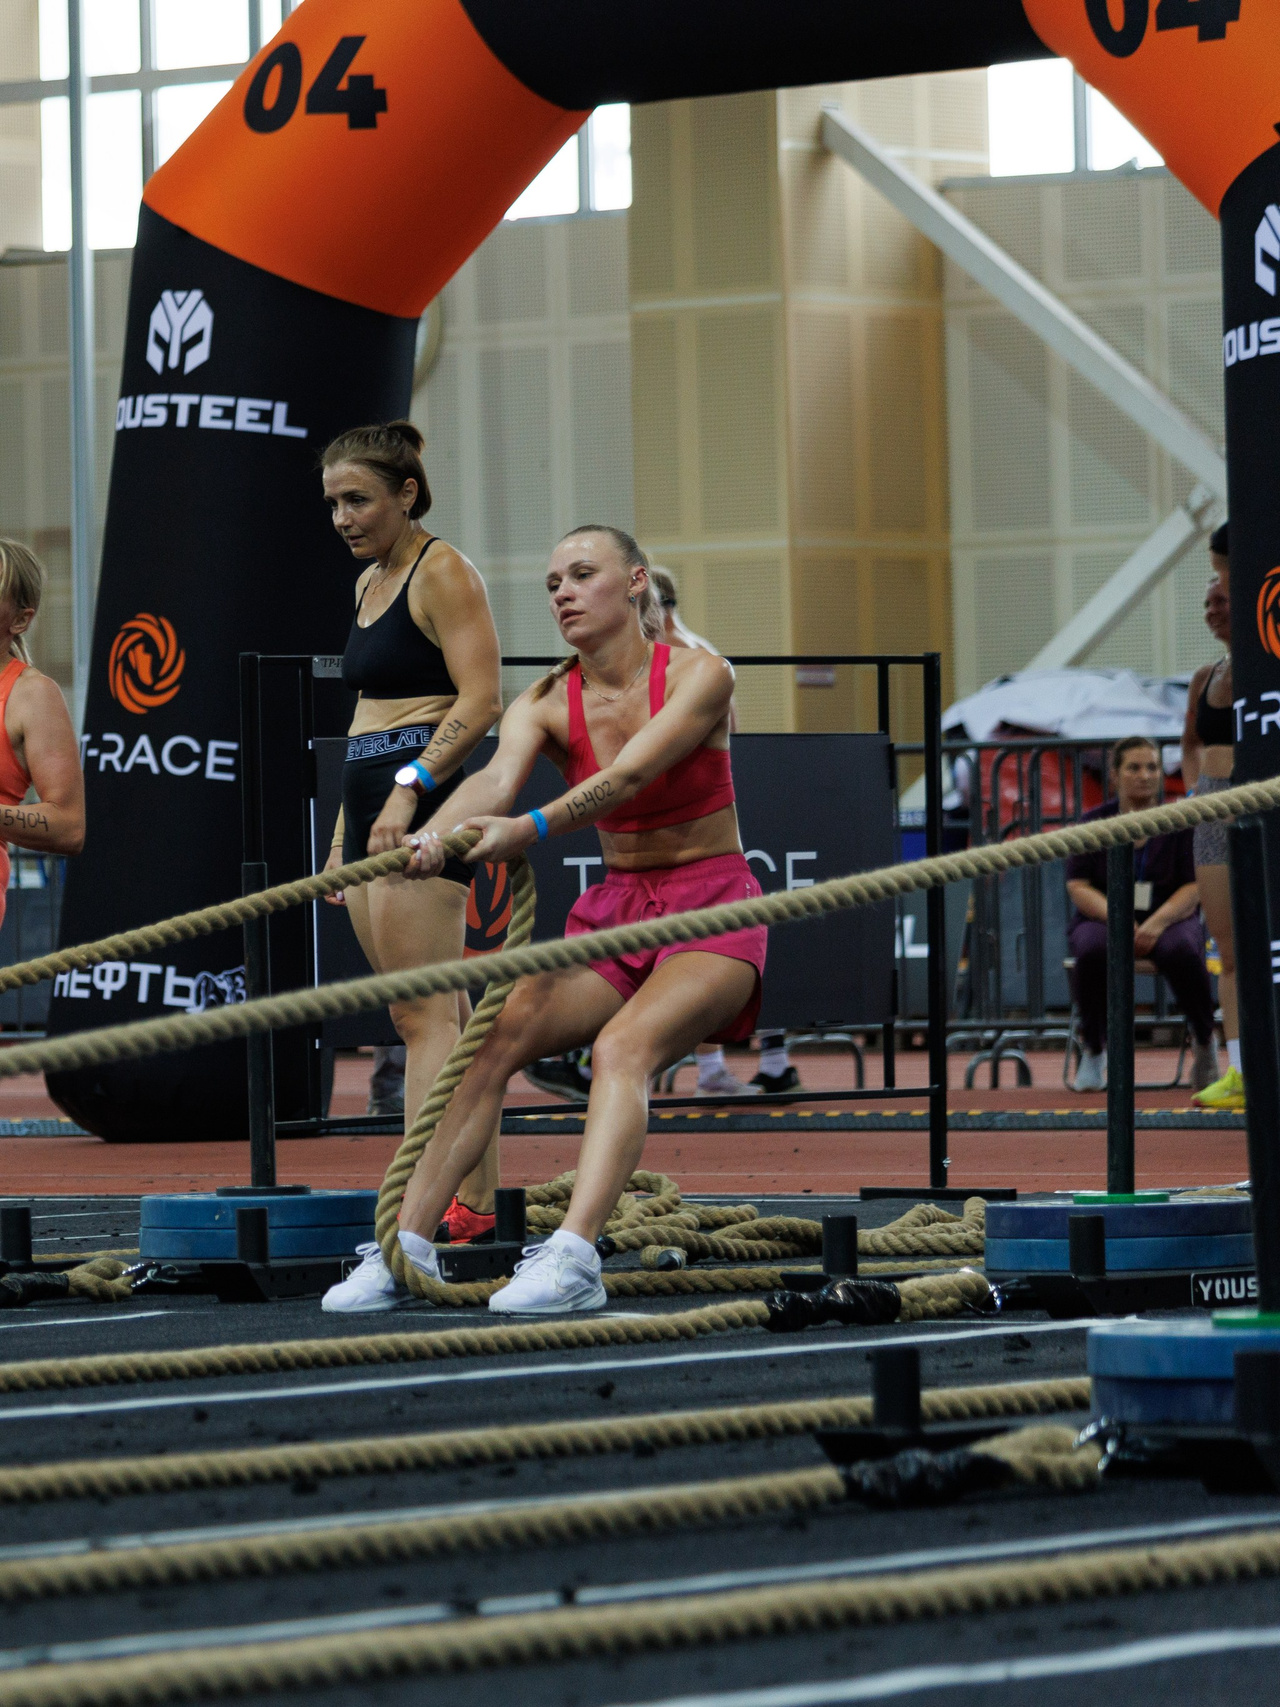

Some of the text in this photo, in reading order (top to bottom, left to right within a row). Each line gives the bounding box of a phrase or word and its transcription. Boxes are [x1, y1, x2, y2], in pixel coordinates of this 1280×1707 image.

[243, 36, 388, 135] 04
[419, 719, 468, 765] 15404
[566, 780, 615, 821] 15402
